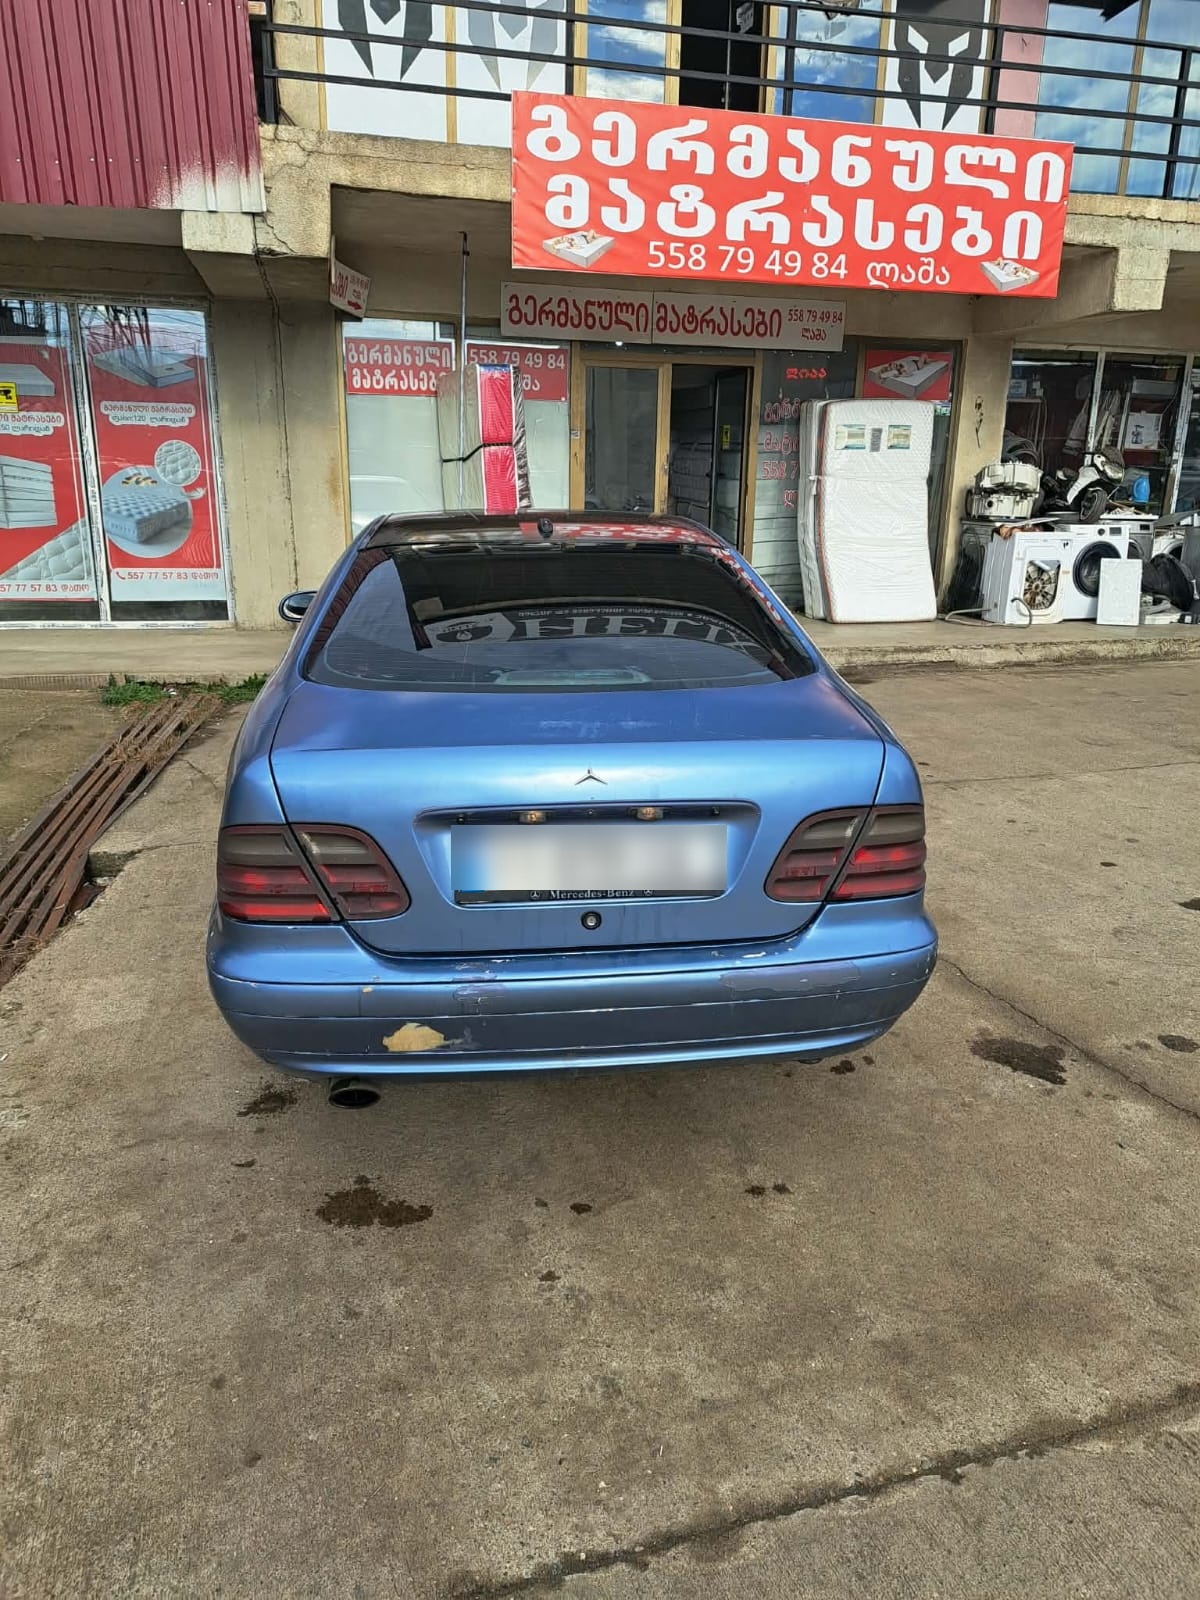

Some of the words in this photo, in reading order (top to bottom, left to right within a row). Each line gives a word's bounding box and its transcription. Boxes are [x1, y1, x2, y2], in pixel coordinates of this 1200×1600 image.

[526, 104, 1066, 203] გერმანული
[544, 173, 1043, 260] მატრასები
[647, 240, 706, 271] 558
[718, 245, 755, 274] 79
[764, 248, 802, 277] 49
[811, 251, 848, 279] 84
[866, 257, 951, 289] ლაშა
[508, 294, 650, 333] გერმანული
[656, 302, 782, 338] მატრასები
[788, 309, 804, 322] 558
[807, 309, 818, 323] 79
[819, 310, 831, 323] 49
[832, 311, 843, 324] 84
[801, 328, 827, 341] ლაშა
[348, 342, 451, 368] გერმანული
[469, 349, 498, 364] 558
[502, 350, 520, 367] 79
[524, 352, 543, 368] 49
[547, 353, 565, 370] 84
[352, 367, 446, 391] მატრასებ
[523, 374, 540, 391] შა
[760, 460, 787, 479] 558
[790, 460, 799, 480] 7
[127, 571, 144, 580] 557
[148, 572, 159, 580] 77
[162, 572, 173, 580] 57
[176, 572, 188, 580] 83
[0, 583, 11, 592] 57
[15, 584, 26, 592] 77
[30, 584, 42, 592] 57
[45, 584, 58, 592] 83
[550, 889, 635, 900] Mercedes-Benz
